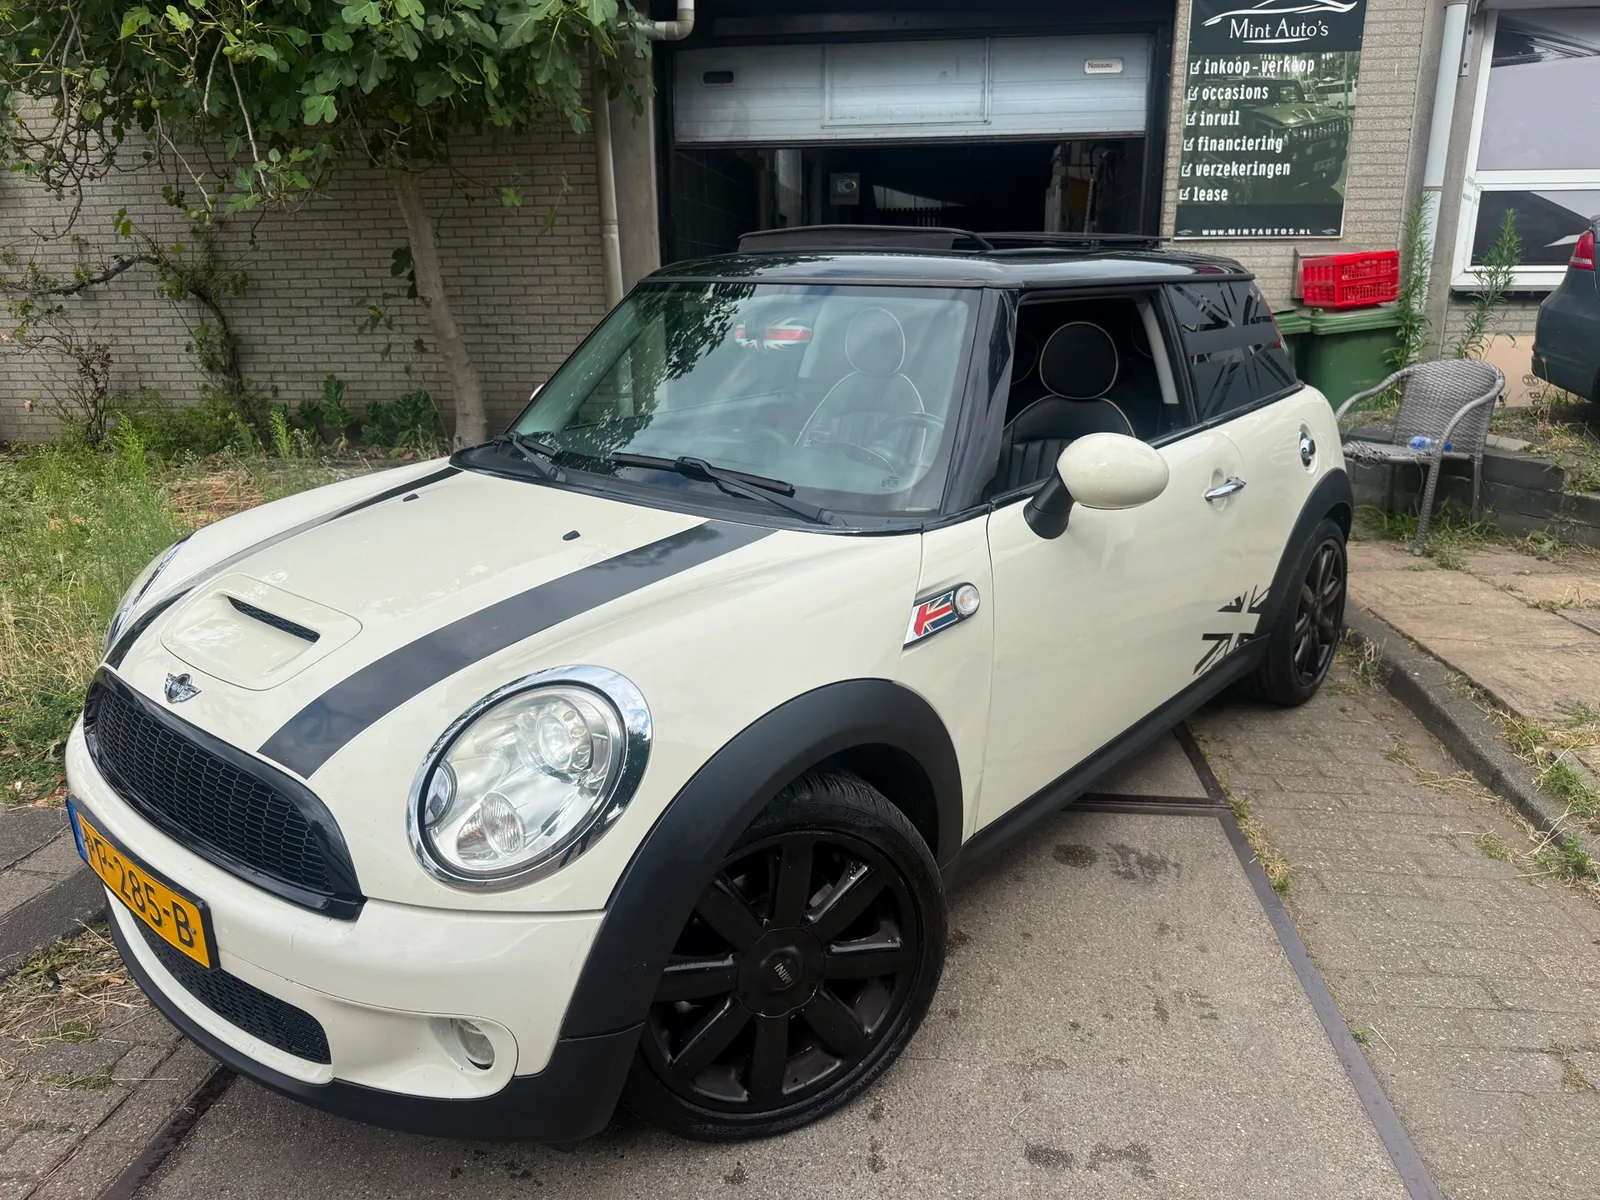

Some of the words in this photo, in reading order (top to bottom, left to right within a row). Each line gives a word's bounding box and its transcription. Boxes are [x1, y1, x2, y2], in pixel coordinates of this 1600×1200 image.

[1229, 18, 1271, 39] Mint
[1275, 17, 1329, 37] Auto's
[1202, 84, 1269, 100] occasions
[1199, 110, 1240, 126] inruil
[1197, 136, 1283, 153] financiering
[1195, 161, 1291, 178] verzekeringen
[1192, 187, 1228, 201] lease
[774, 962, 793, 985] MINI
